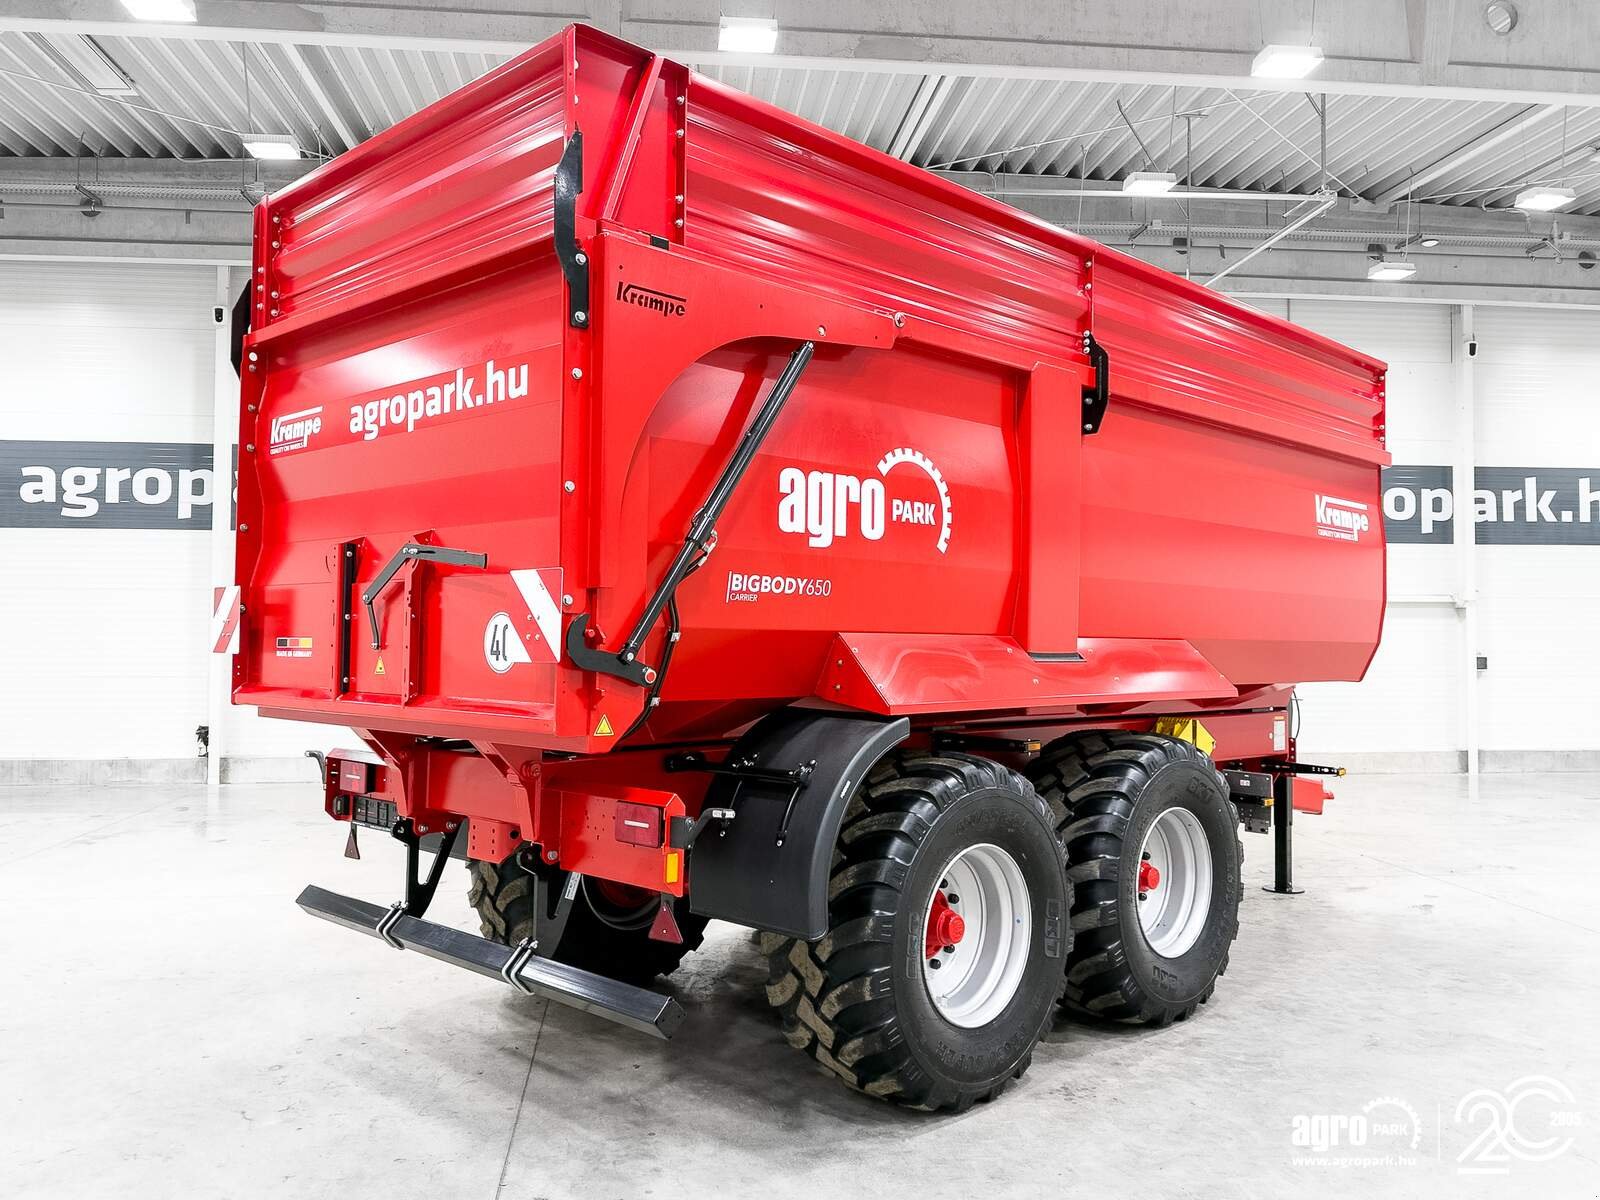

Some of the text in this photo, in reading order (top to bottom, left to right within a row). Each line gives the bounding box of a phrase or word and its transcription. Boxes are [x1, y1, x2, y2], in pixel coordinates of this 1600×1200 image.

[616, 281, 687, 317] Krampe
[349, 360, 529, 441] agropark.hu
[270, 406, 324, 448] Krampe
[19, 465, 238, 520] agrop
[778, 467, 936, 548] agro PARK
[1314, 493, 1369, 542] Krampe
[729, 592, 758, 602] CARRIER
